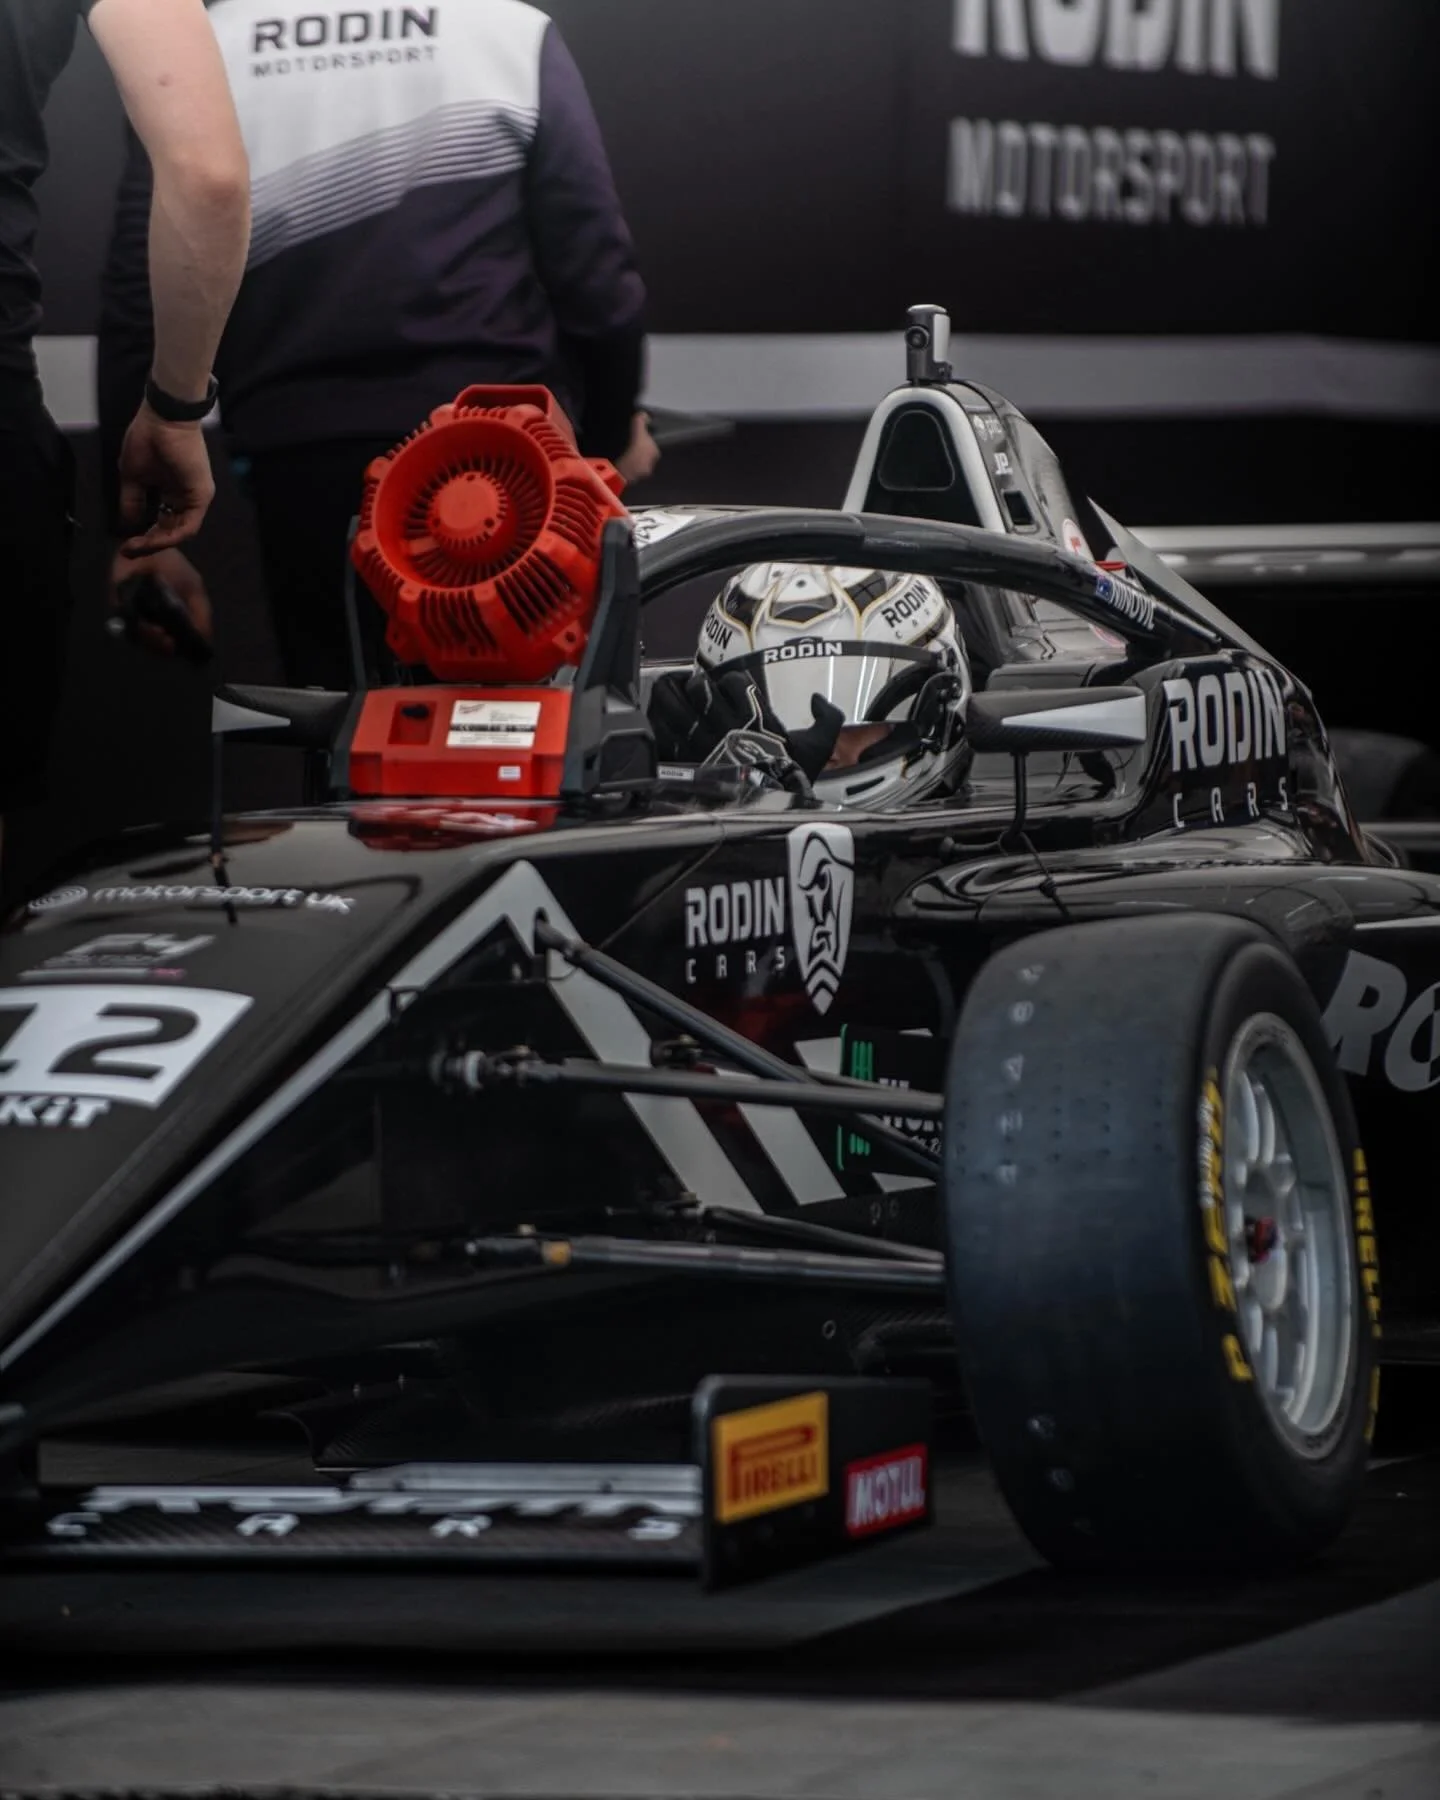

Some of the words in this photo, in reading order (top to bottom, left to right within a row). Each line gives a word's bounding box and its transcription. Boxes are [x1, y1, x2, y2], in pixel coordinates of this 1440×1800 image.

[253, 6, 438, 53] RODIN
[253, 46, 437, 78] MOTORSPORT
[946, 116, 1276, 228] MOTORSPORT
[881, 579, 930, 629] RODIN
[764, 641, 843, 664] RODIN
[1163, 668, 1286, 772] RODIN
[1172, 776, 1288, 829] CARS
[686, 876, 785, 947] RODIN
[687, 946, 785, 984] CARS
[727, 1422, 820, 1507] PIRELLI
[847, 1455, 926, 1529] MOTUL
